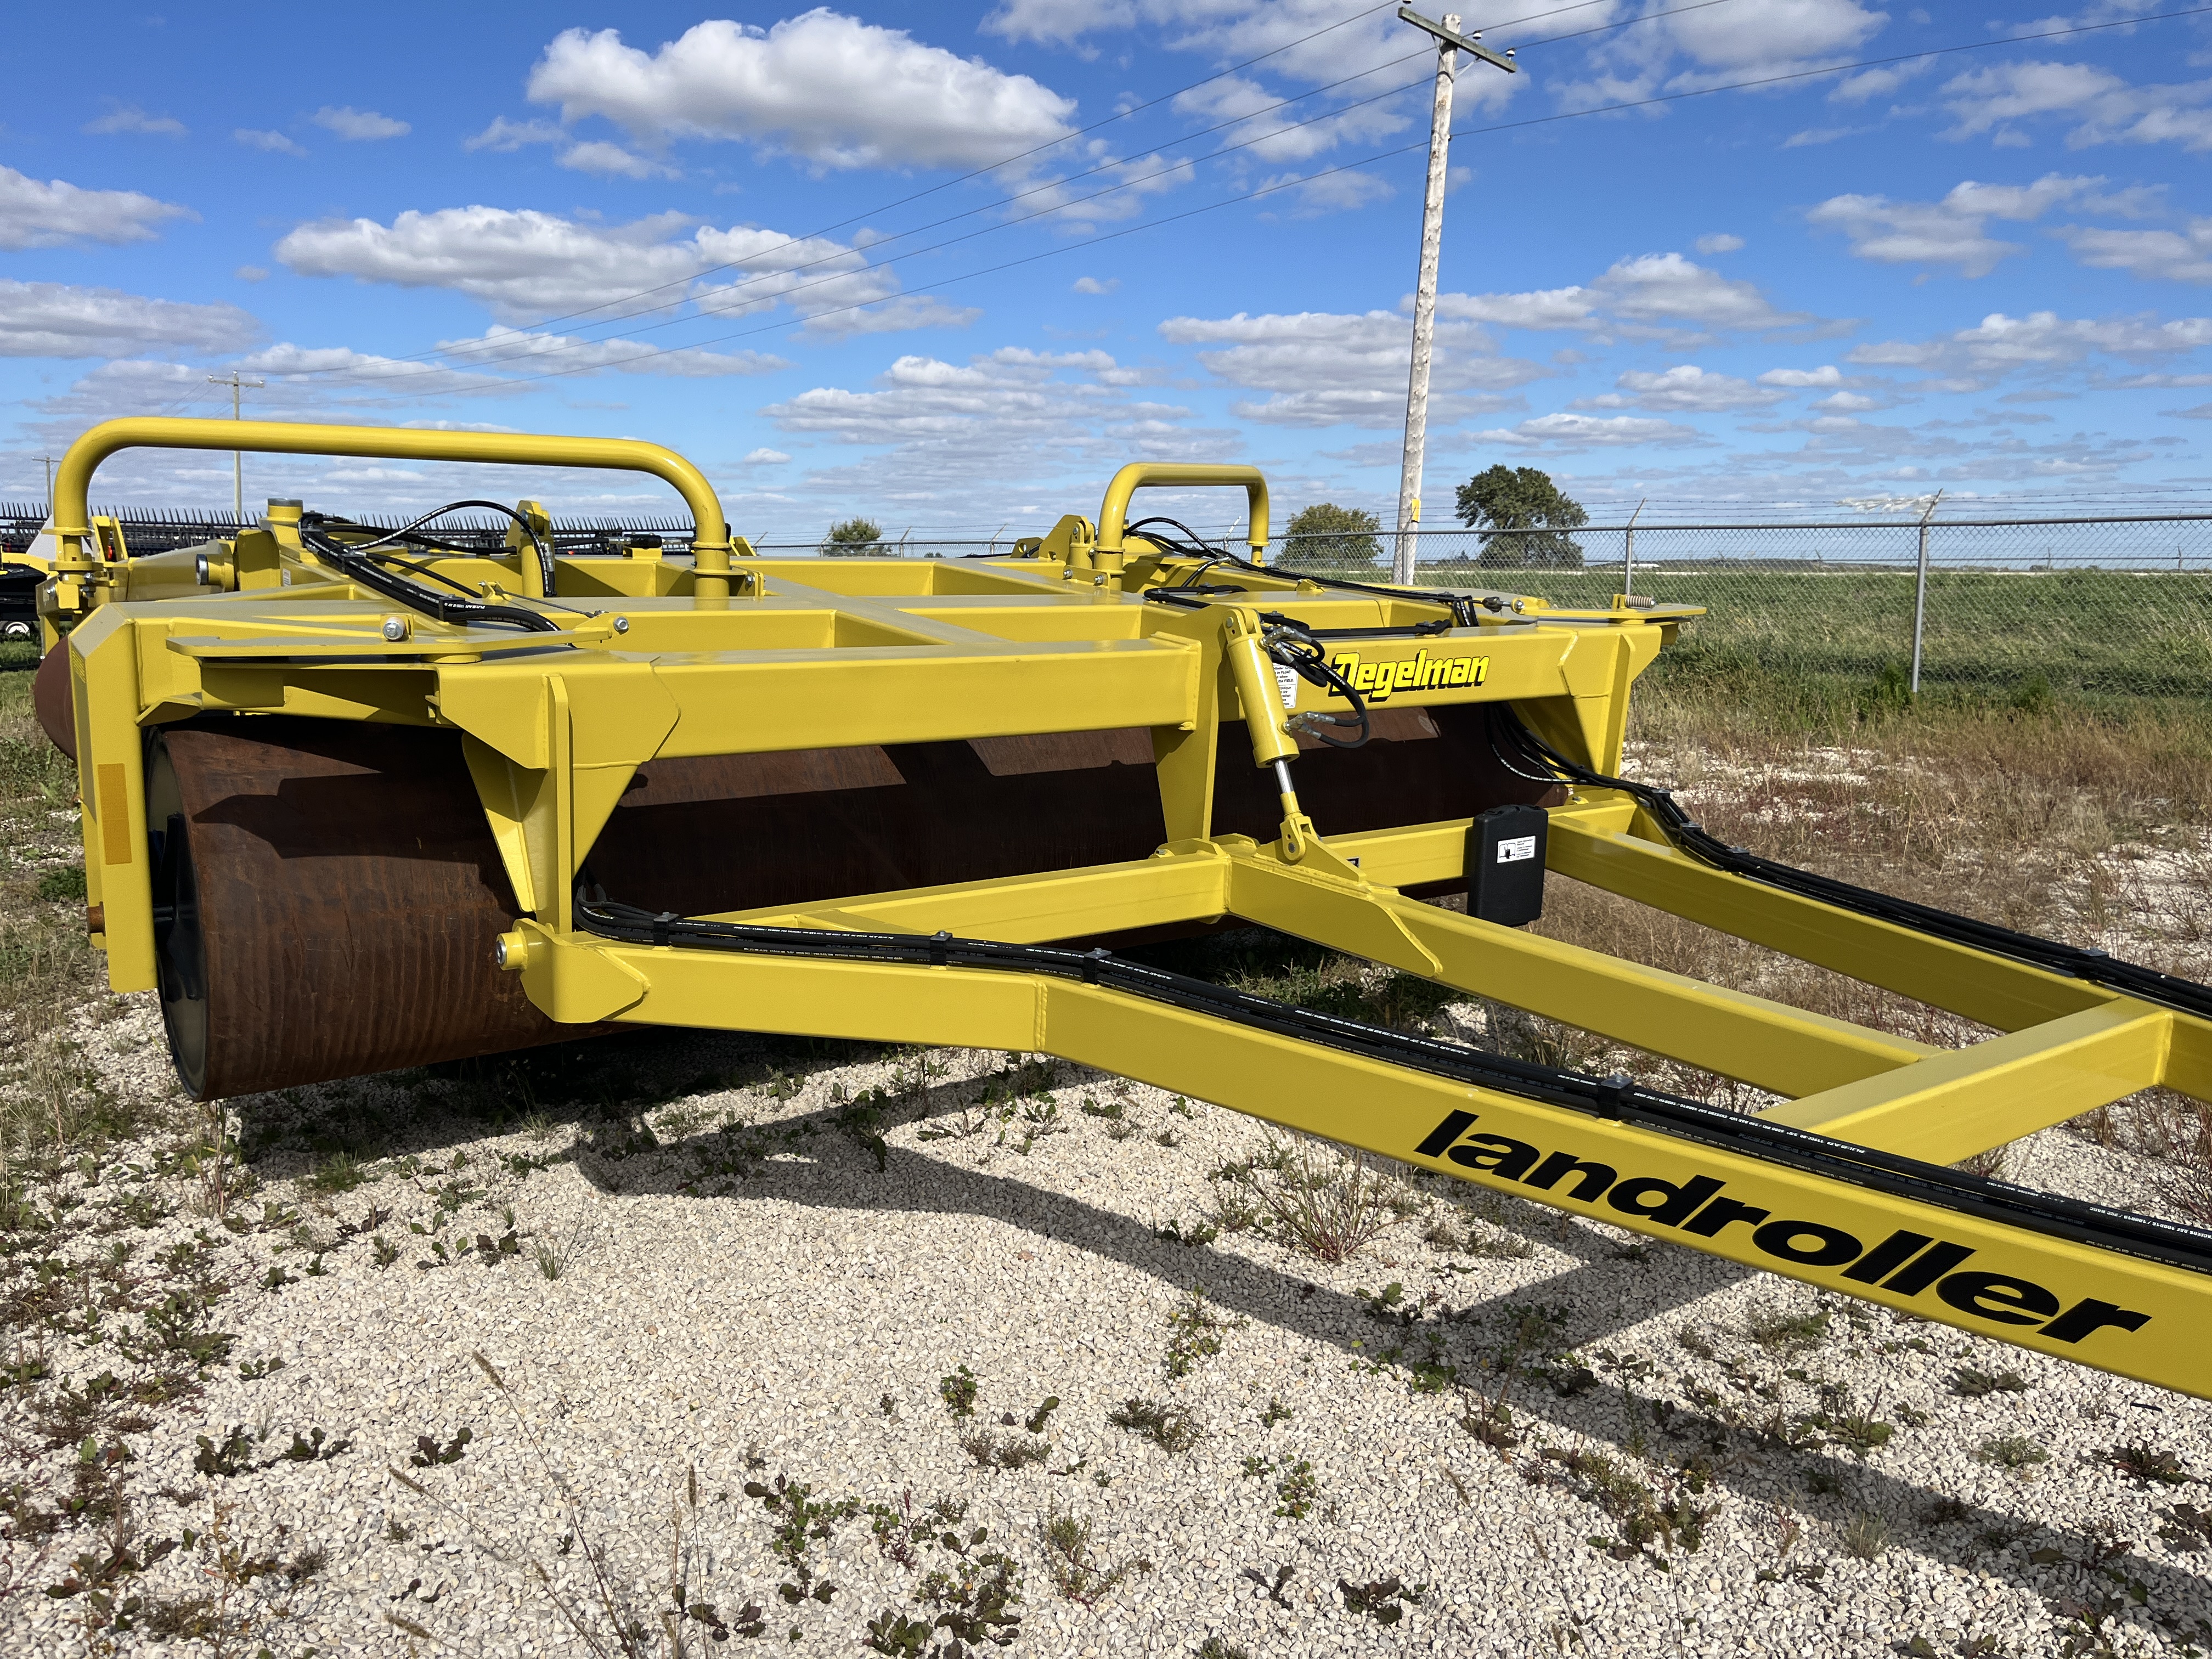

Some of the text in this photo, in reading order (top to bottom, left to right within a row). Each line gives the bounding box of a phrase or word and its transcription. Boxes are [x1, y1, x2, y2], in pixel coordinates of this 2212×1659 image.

[1328, 650, 1489, 702] Degelman
[1414, 1109, 2152, 1344] landroller
[2188, 1229, 2212, 1239] XCEEDS
